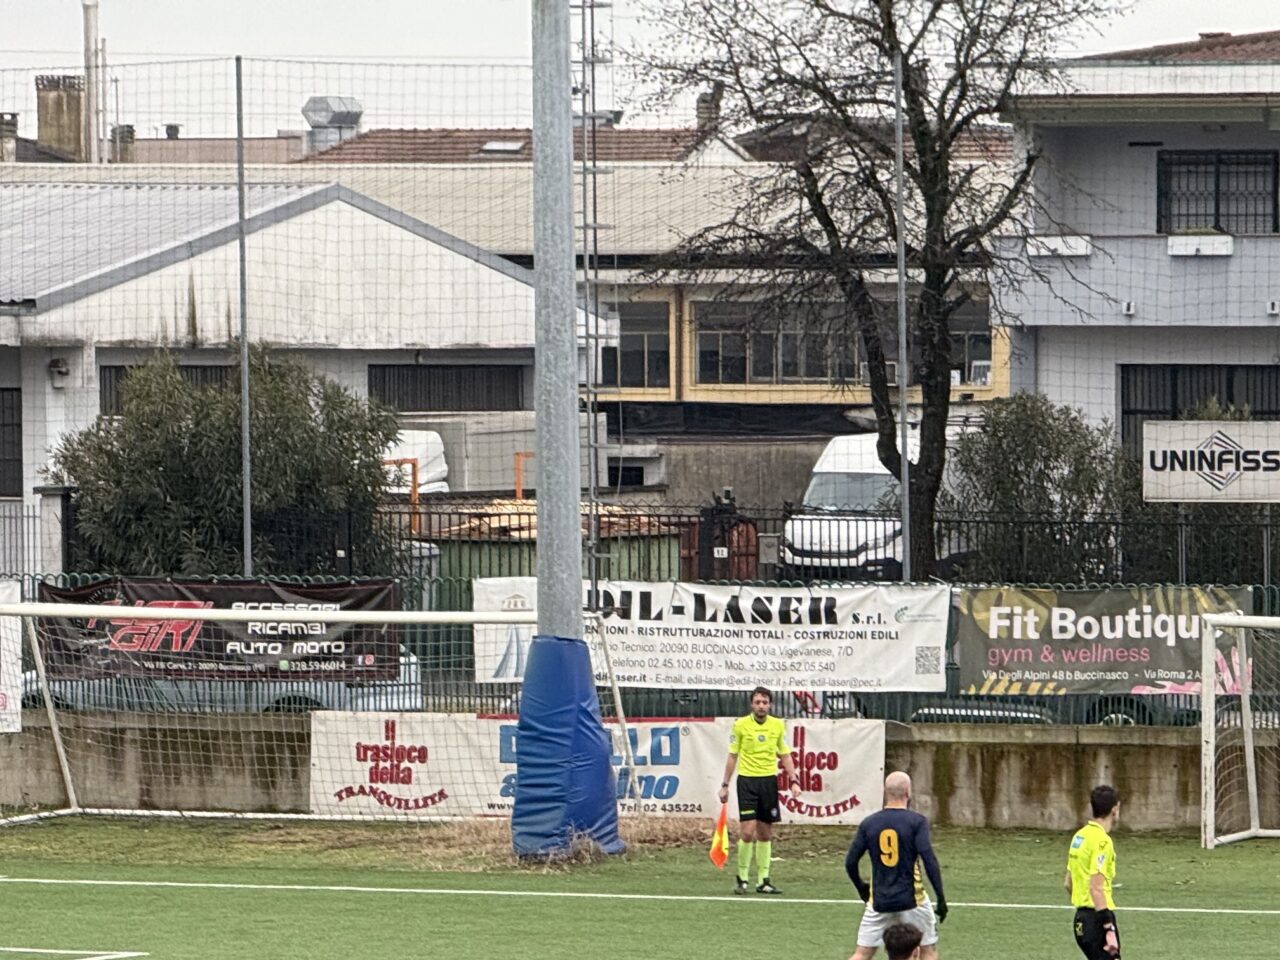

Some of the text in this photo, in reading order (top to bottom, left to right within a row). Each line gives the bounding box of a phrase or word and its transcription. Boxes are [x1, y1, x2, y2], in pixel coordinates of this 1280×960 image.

[587, 587, 838, 625] DIL-LASER
[247, 622, 326, 635] RICAMBI
[988, 606, 1222, 647] Fit Boutiqu
[637, 627, 743, 638] RISTRUTTURAZIONI
[746, 629, 784, 639] TOTALI
[794, 630, 867, 640] COSTRUZIONI
[871, 631, 899, 641] EDILI
[226, 641, 345, 655] AUTO MOTO
[659, 643, 689, 654] 20090
[691, 643, 759, 656] BUCCINASCO
[761, 645, 777, 656] Via
[988, 644, 1150, 666] gym & wellness
[611, 658, 645, 668] elefono
[982, 670, 998, 680] Via
[998, 670, 1023, 681] Degli
[1024, 670, 1051, 680] Alpini
[1052, 671, 1065, 680] 48
[1074, 670, 1129, 680] Buccinasco
[1157, 669, 1186, 680] Roma
[1186, 669, 1194, 679] 2
[355, 741, 429, 764] trasloco
[369, 762, 413, 784] della
[643, 803, 657, 812] 02
[661, 803, 703, 813] 435224
[879, 829, 899, 867] 9
